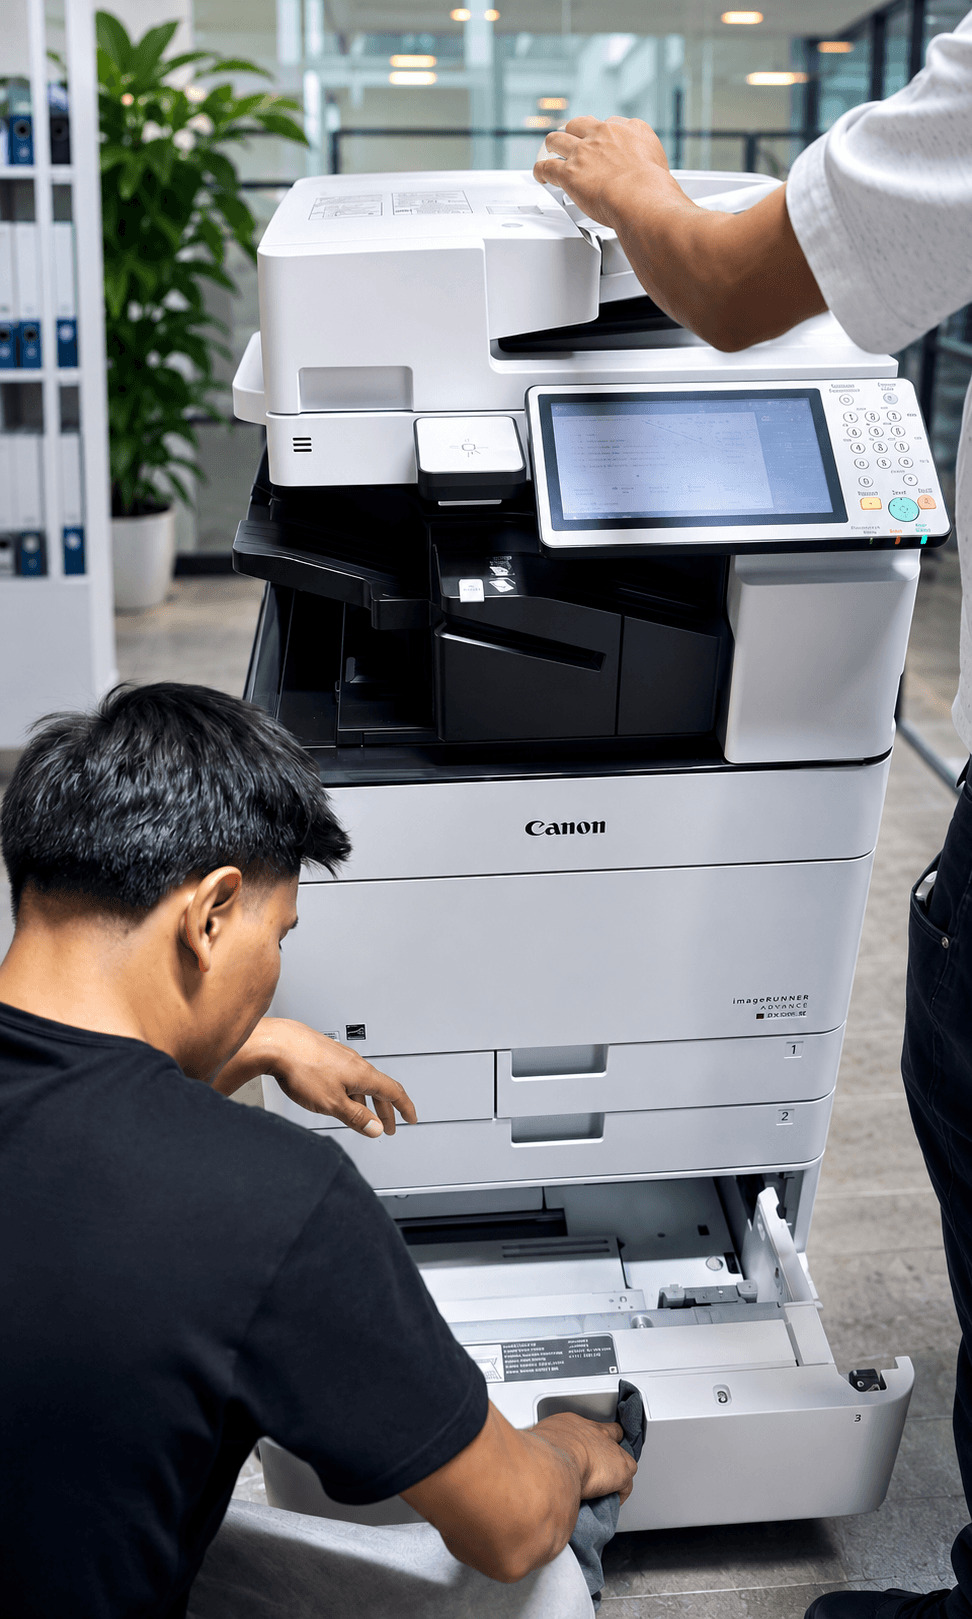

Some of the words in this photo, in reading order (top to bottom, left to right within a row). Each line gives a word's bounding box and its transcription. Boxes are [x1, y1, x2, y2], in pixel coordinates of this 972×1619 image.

[525, 820, 606, 836] Canon
[732, 994, 809, 1005] imageRUNNER
[791, 1044, 796, 1054] 1
[781, 1111, 789, 1121] 2
[854, 1414, 862, 1423] 3
